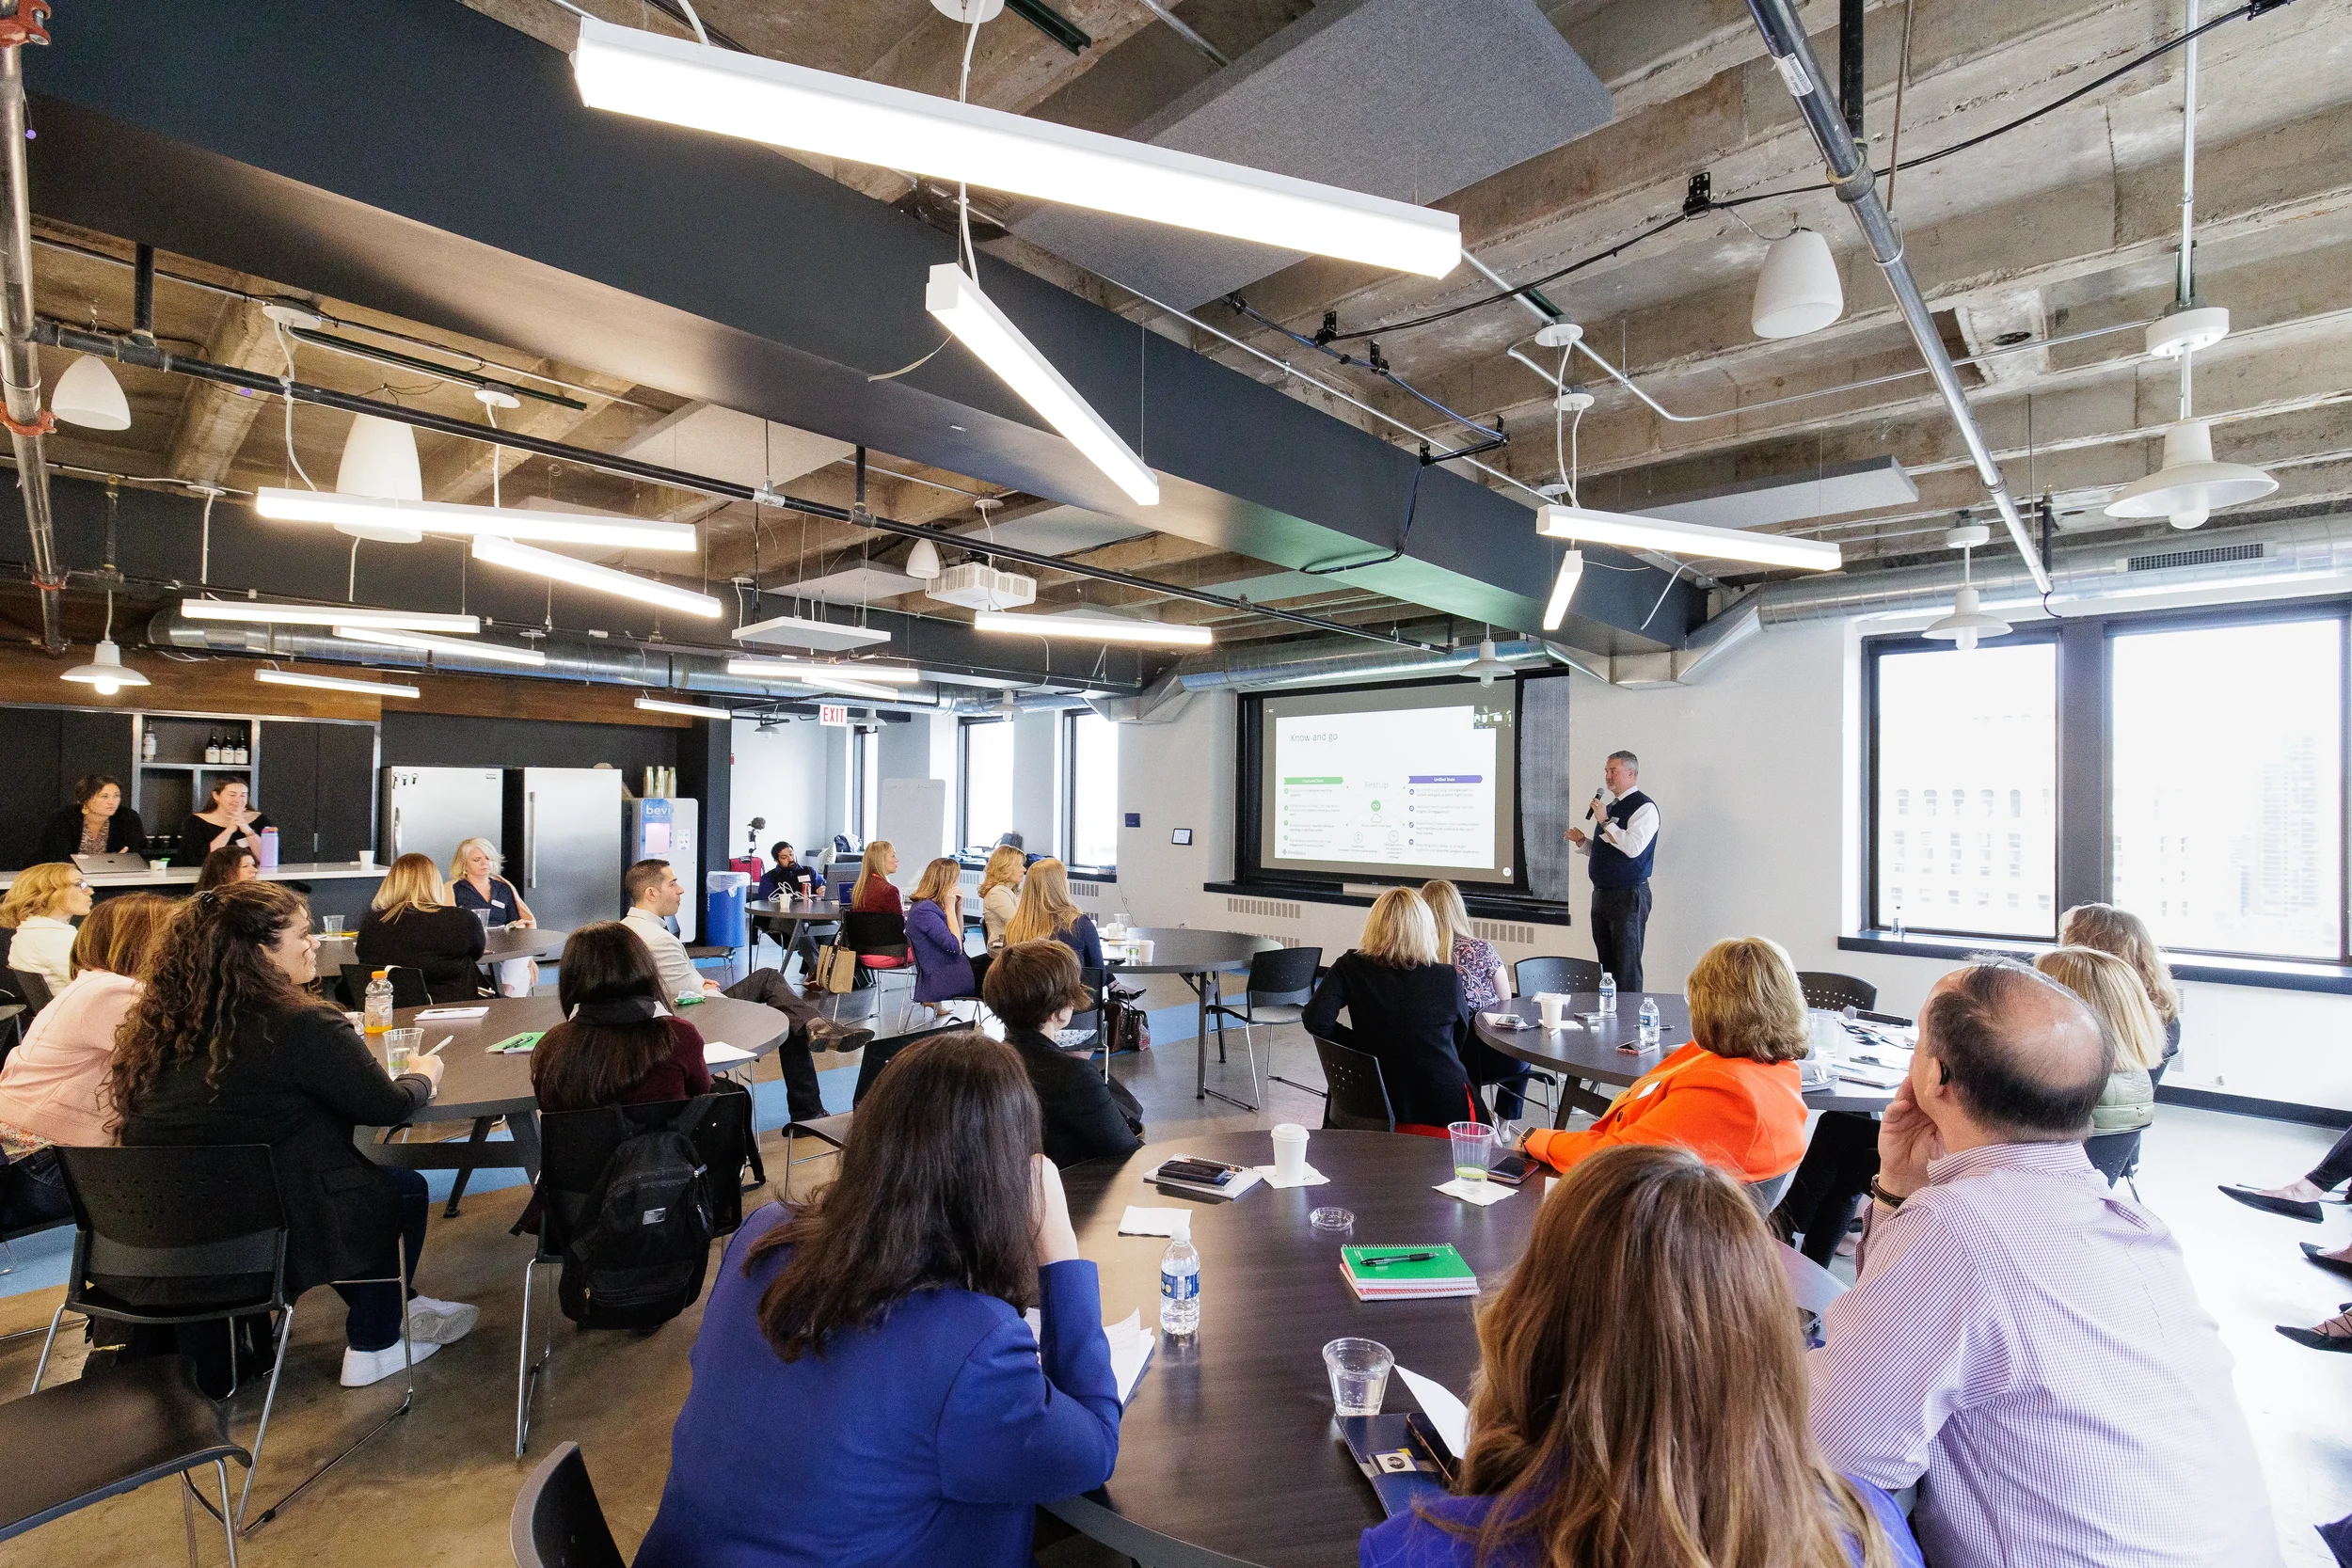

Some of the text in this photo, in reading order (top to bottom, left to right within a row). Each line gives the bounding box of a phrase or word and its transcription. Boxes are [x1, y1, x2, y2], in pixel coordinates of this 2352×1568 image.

[823, 706, 844, 722] EXIT
[1291, 732, 1338, 743] Know and go
[645, 804, 671, 816] bevi
